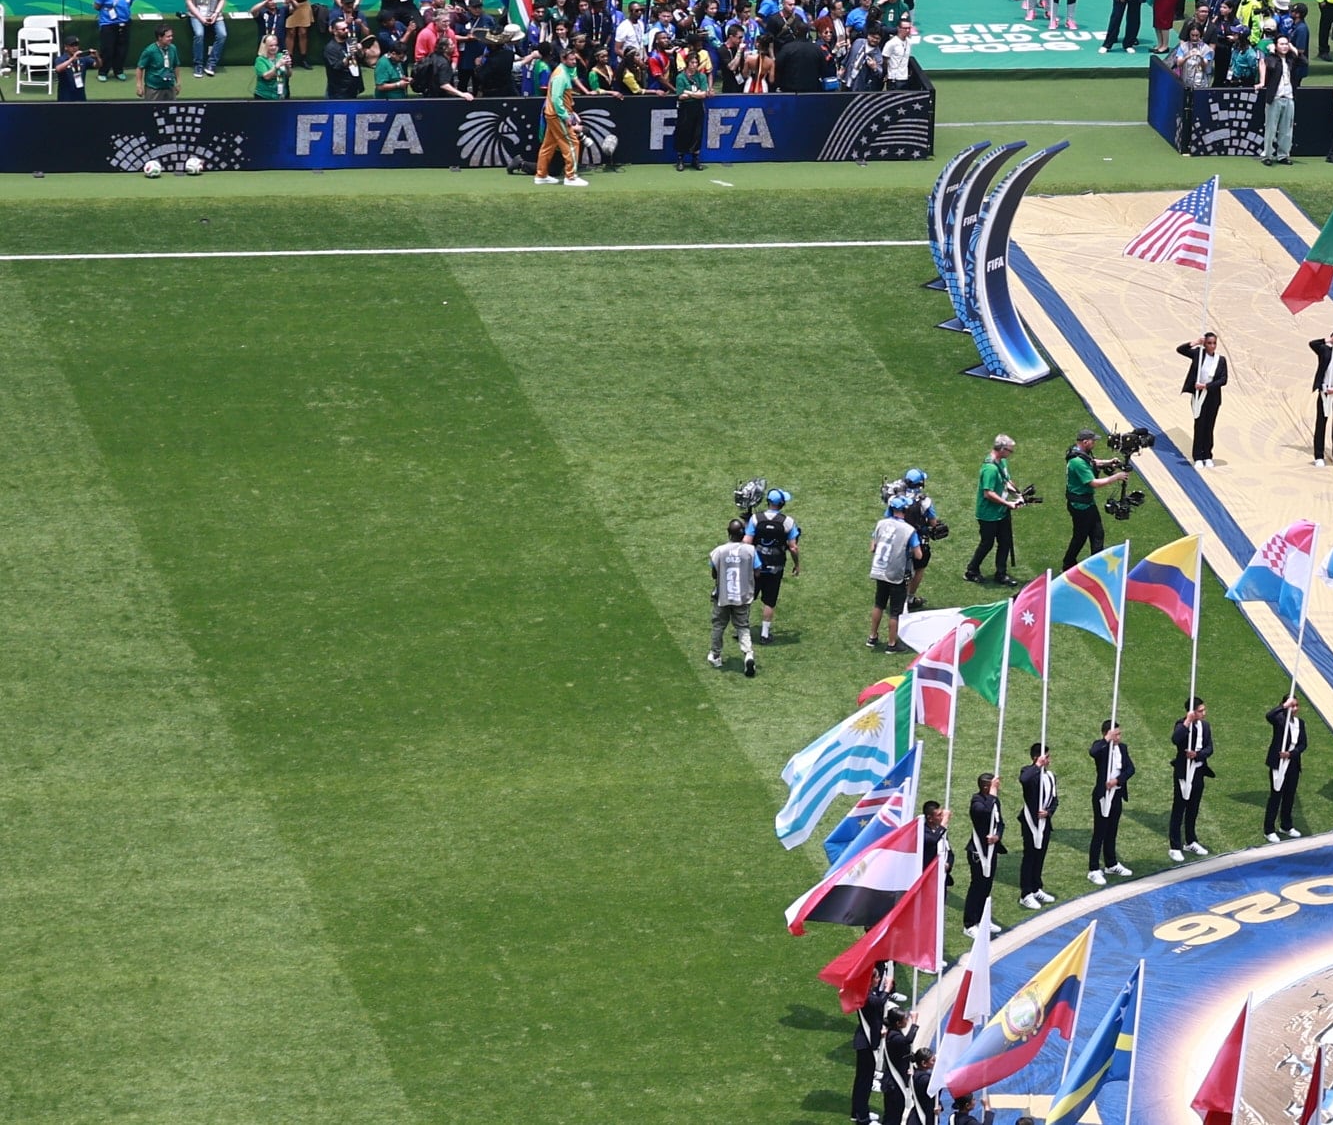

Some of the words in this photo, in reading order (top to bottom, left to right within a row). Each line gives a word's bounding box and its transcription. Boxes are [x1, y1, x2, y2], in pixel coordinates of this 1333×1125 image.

[949, 23, 1039, 34] FIFA
[937, 41, 1081, 54] 2026
[295, 112, 424, 157] FIFA
[648, 107, 776, 151] FFA
[962, 212, 978, 228] FIFA
[986, 255, 1005, 273] FIFA
